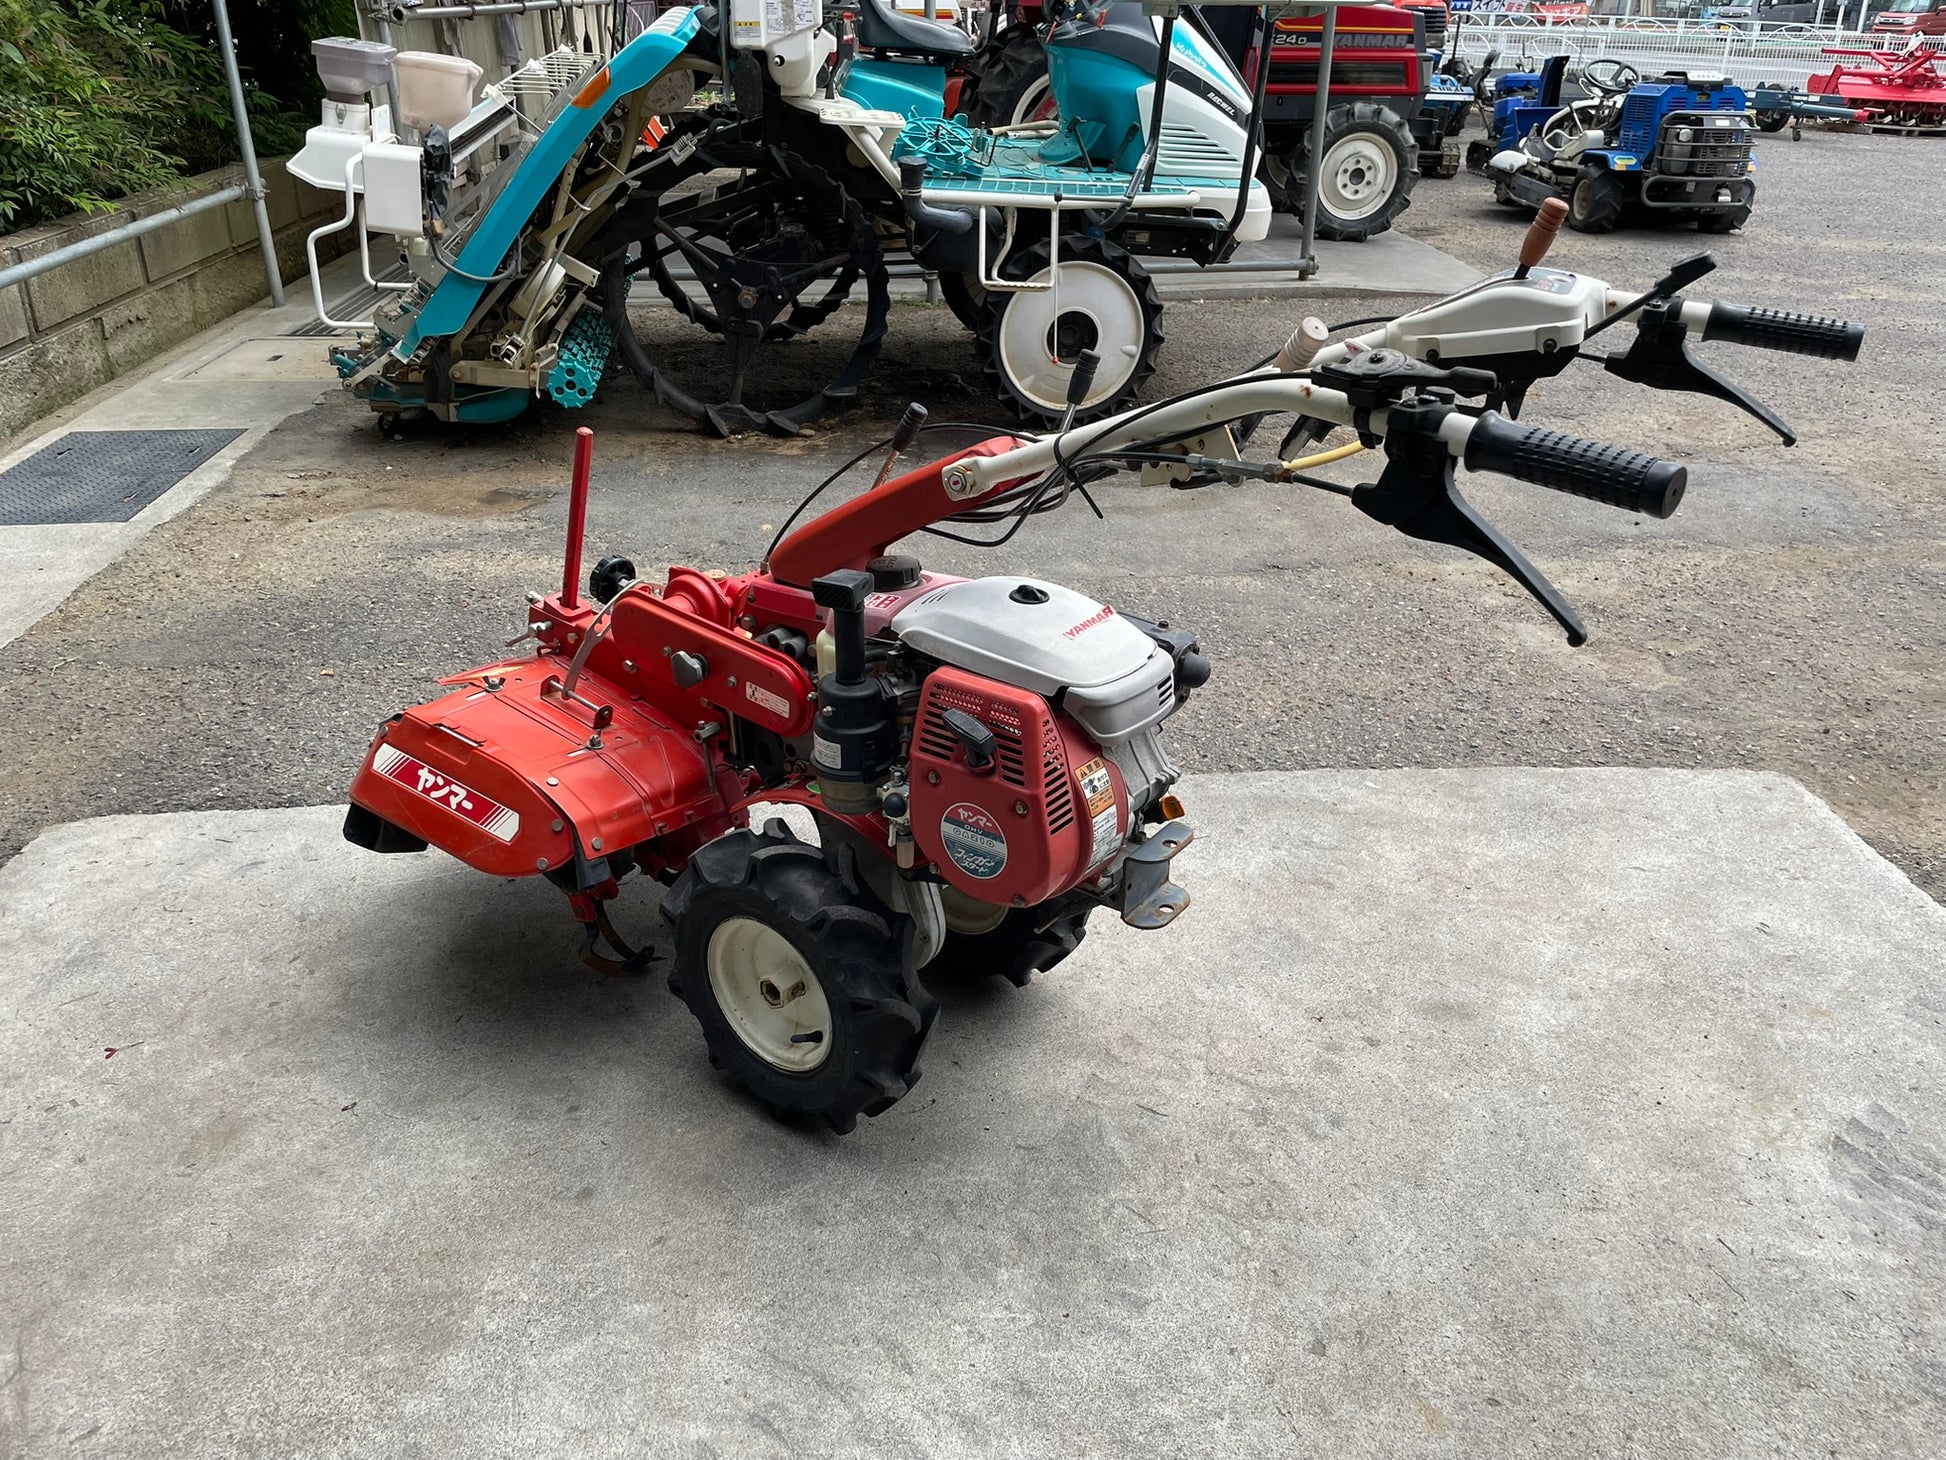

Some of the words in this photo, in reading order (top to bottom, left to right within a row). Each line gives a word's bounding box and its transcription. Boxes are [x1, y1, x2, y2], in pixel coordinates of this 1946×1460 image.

[1272, 34, 1307, 45] 24D
[1207, 92, 1235, 116] RACWEL
[1065, 605, 1114, 637] YANMAR
[417, 767, 474, 810] ヤンマー
[958, 807, 993, 828] ヤンマー
[964, 824, 984, 835] OHV
